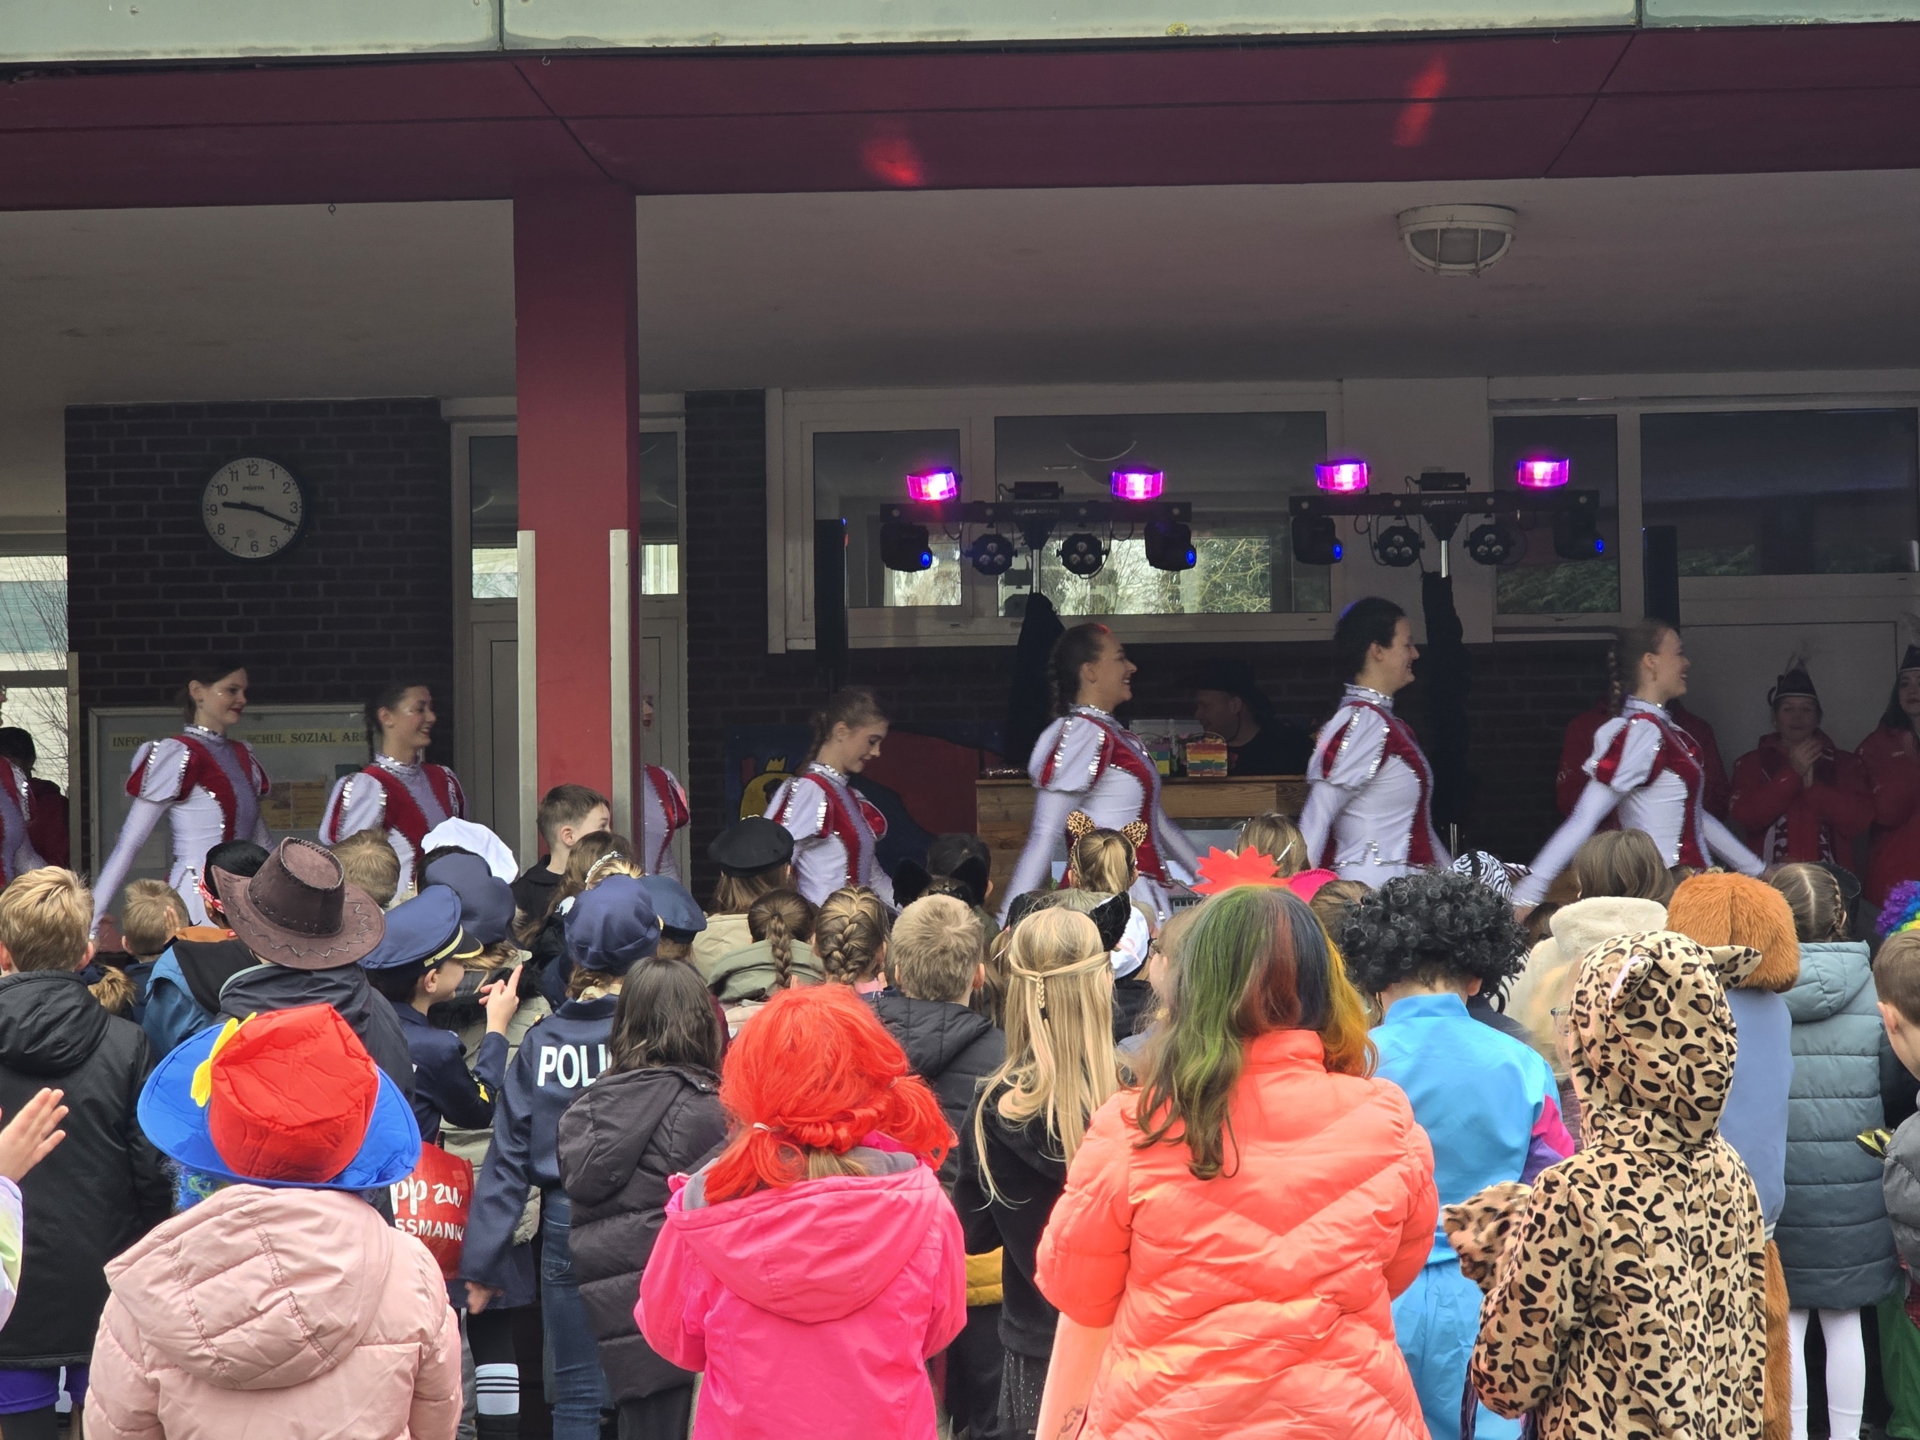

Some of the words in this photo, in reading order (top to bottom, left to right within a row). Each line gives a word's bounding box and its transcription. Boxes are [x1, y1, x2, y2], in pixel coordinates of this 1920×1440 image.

[229, 470, 239, 482] 11
[246, 464, 259, 476] 12
[269, 469, 275, 480] 1
[216, 484, 228, 496] 10
[283, 482, 291, 494] 2
[210, 504, 218, 516] 9
[290, 502, 298, 514] 3
[217, 523, 226, 535] 8
[232, 536, 240, 548] 7
[250, 541, 259, 552] 6
[270, 536, 278, 548] 5
[290, 732, 336, 743] SOZIAL
[537, 1044, 612, 1088] POLI
[432, 1182, 463, 1208] zu
